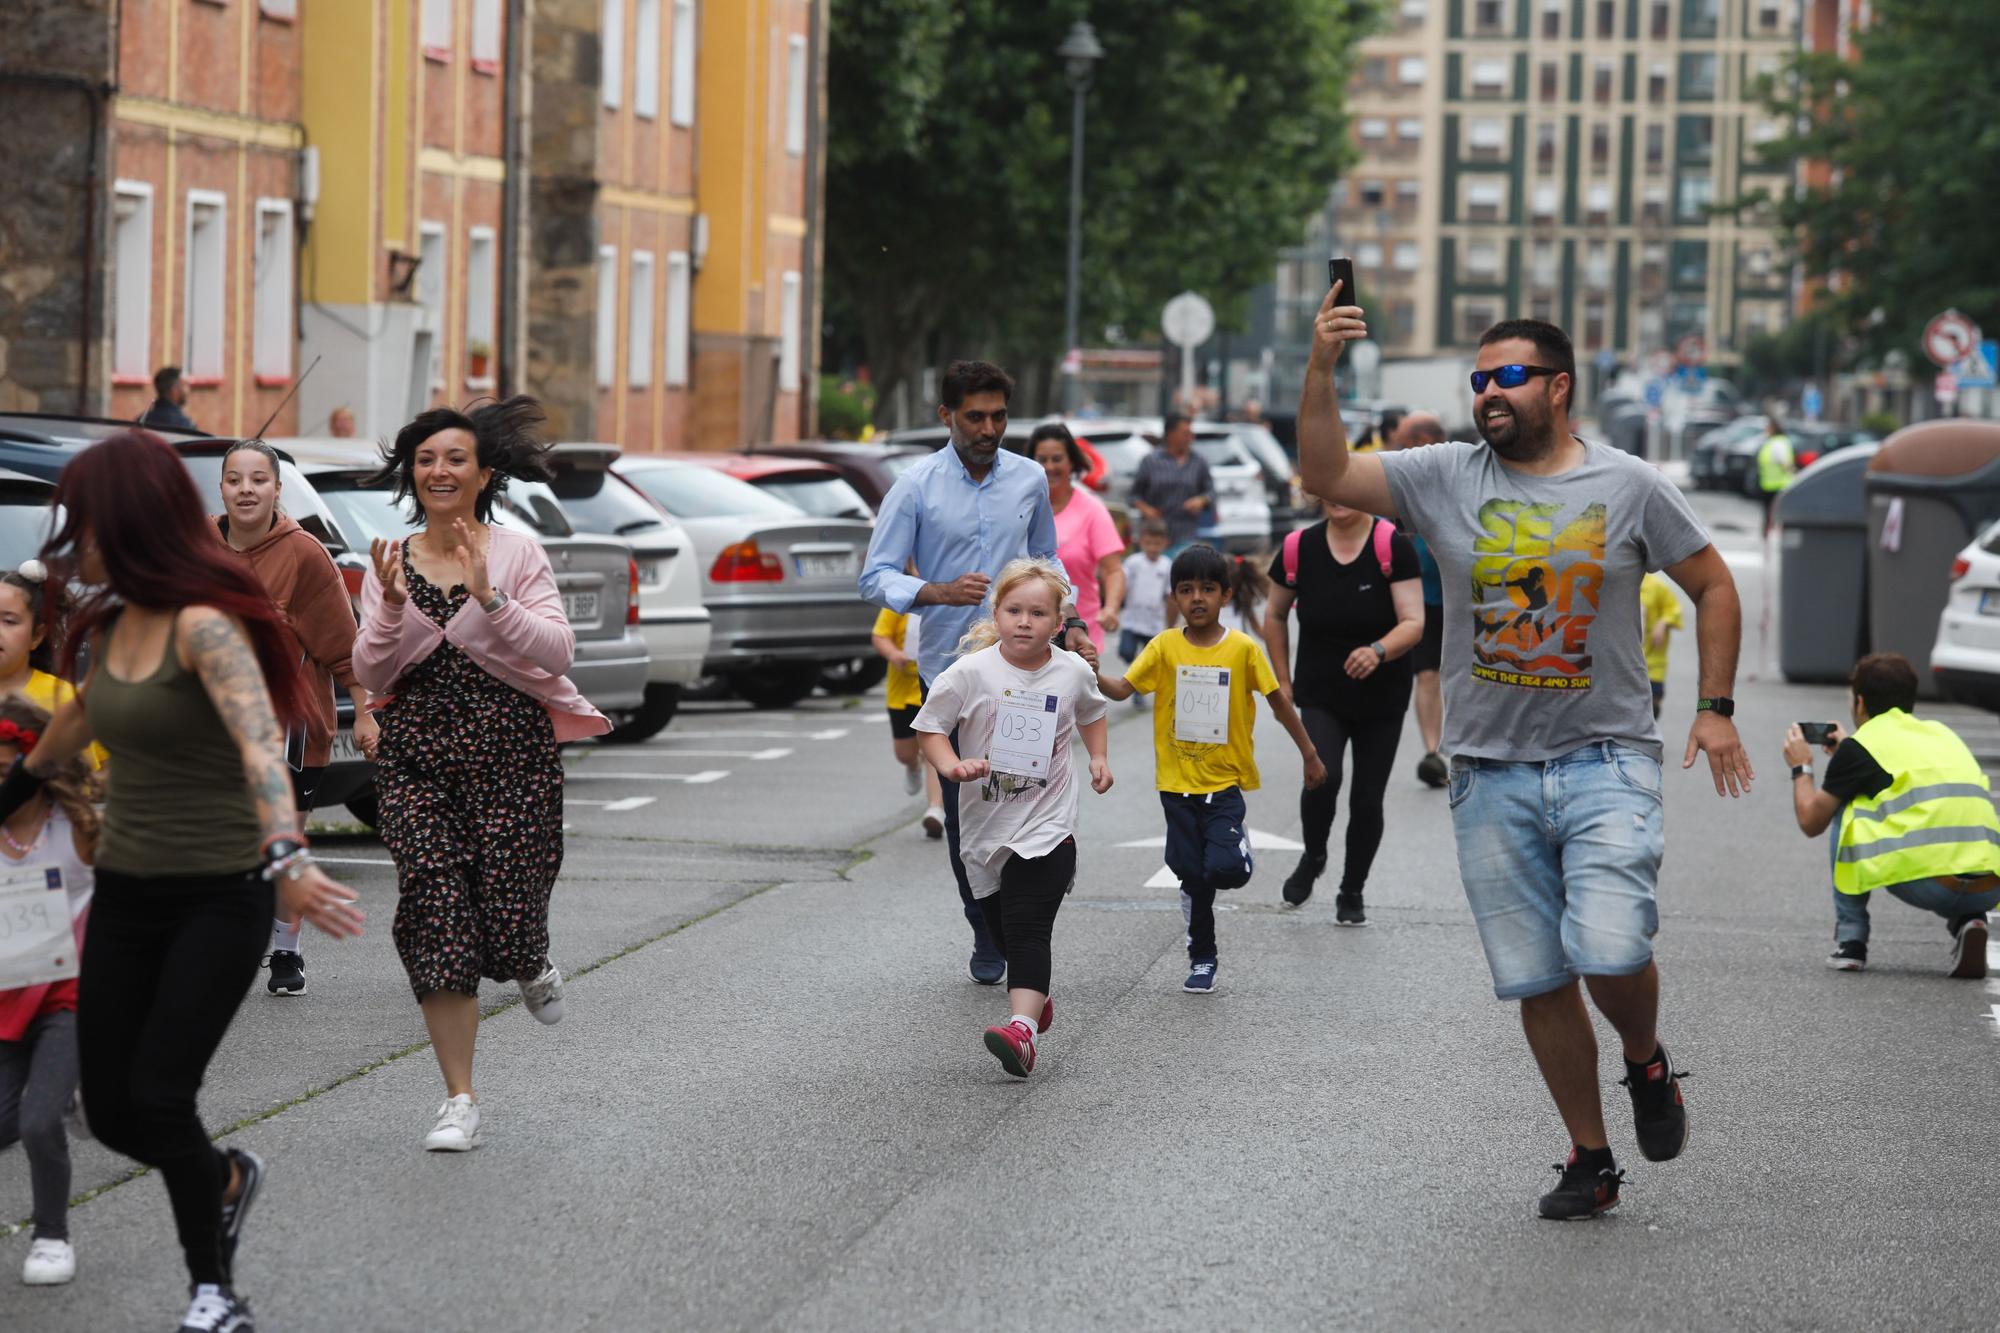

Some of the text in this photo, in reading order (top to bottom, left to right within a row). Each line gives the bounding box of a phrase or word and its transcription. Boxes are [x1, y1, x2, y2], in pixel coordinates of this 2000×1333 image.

[1473, 498, 1607, 559] SEA
[1472, 557, 1604, 612] FOR
[1500, 671, 1517, 685] THE
[1520, 674, 1541, 687] SEA
[1543, 677, 1568, 689] AND
[1571, 678, 1591, 689] SUN
[1001, 713, 1042, 742] 033
